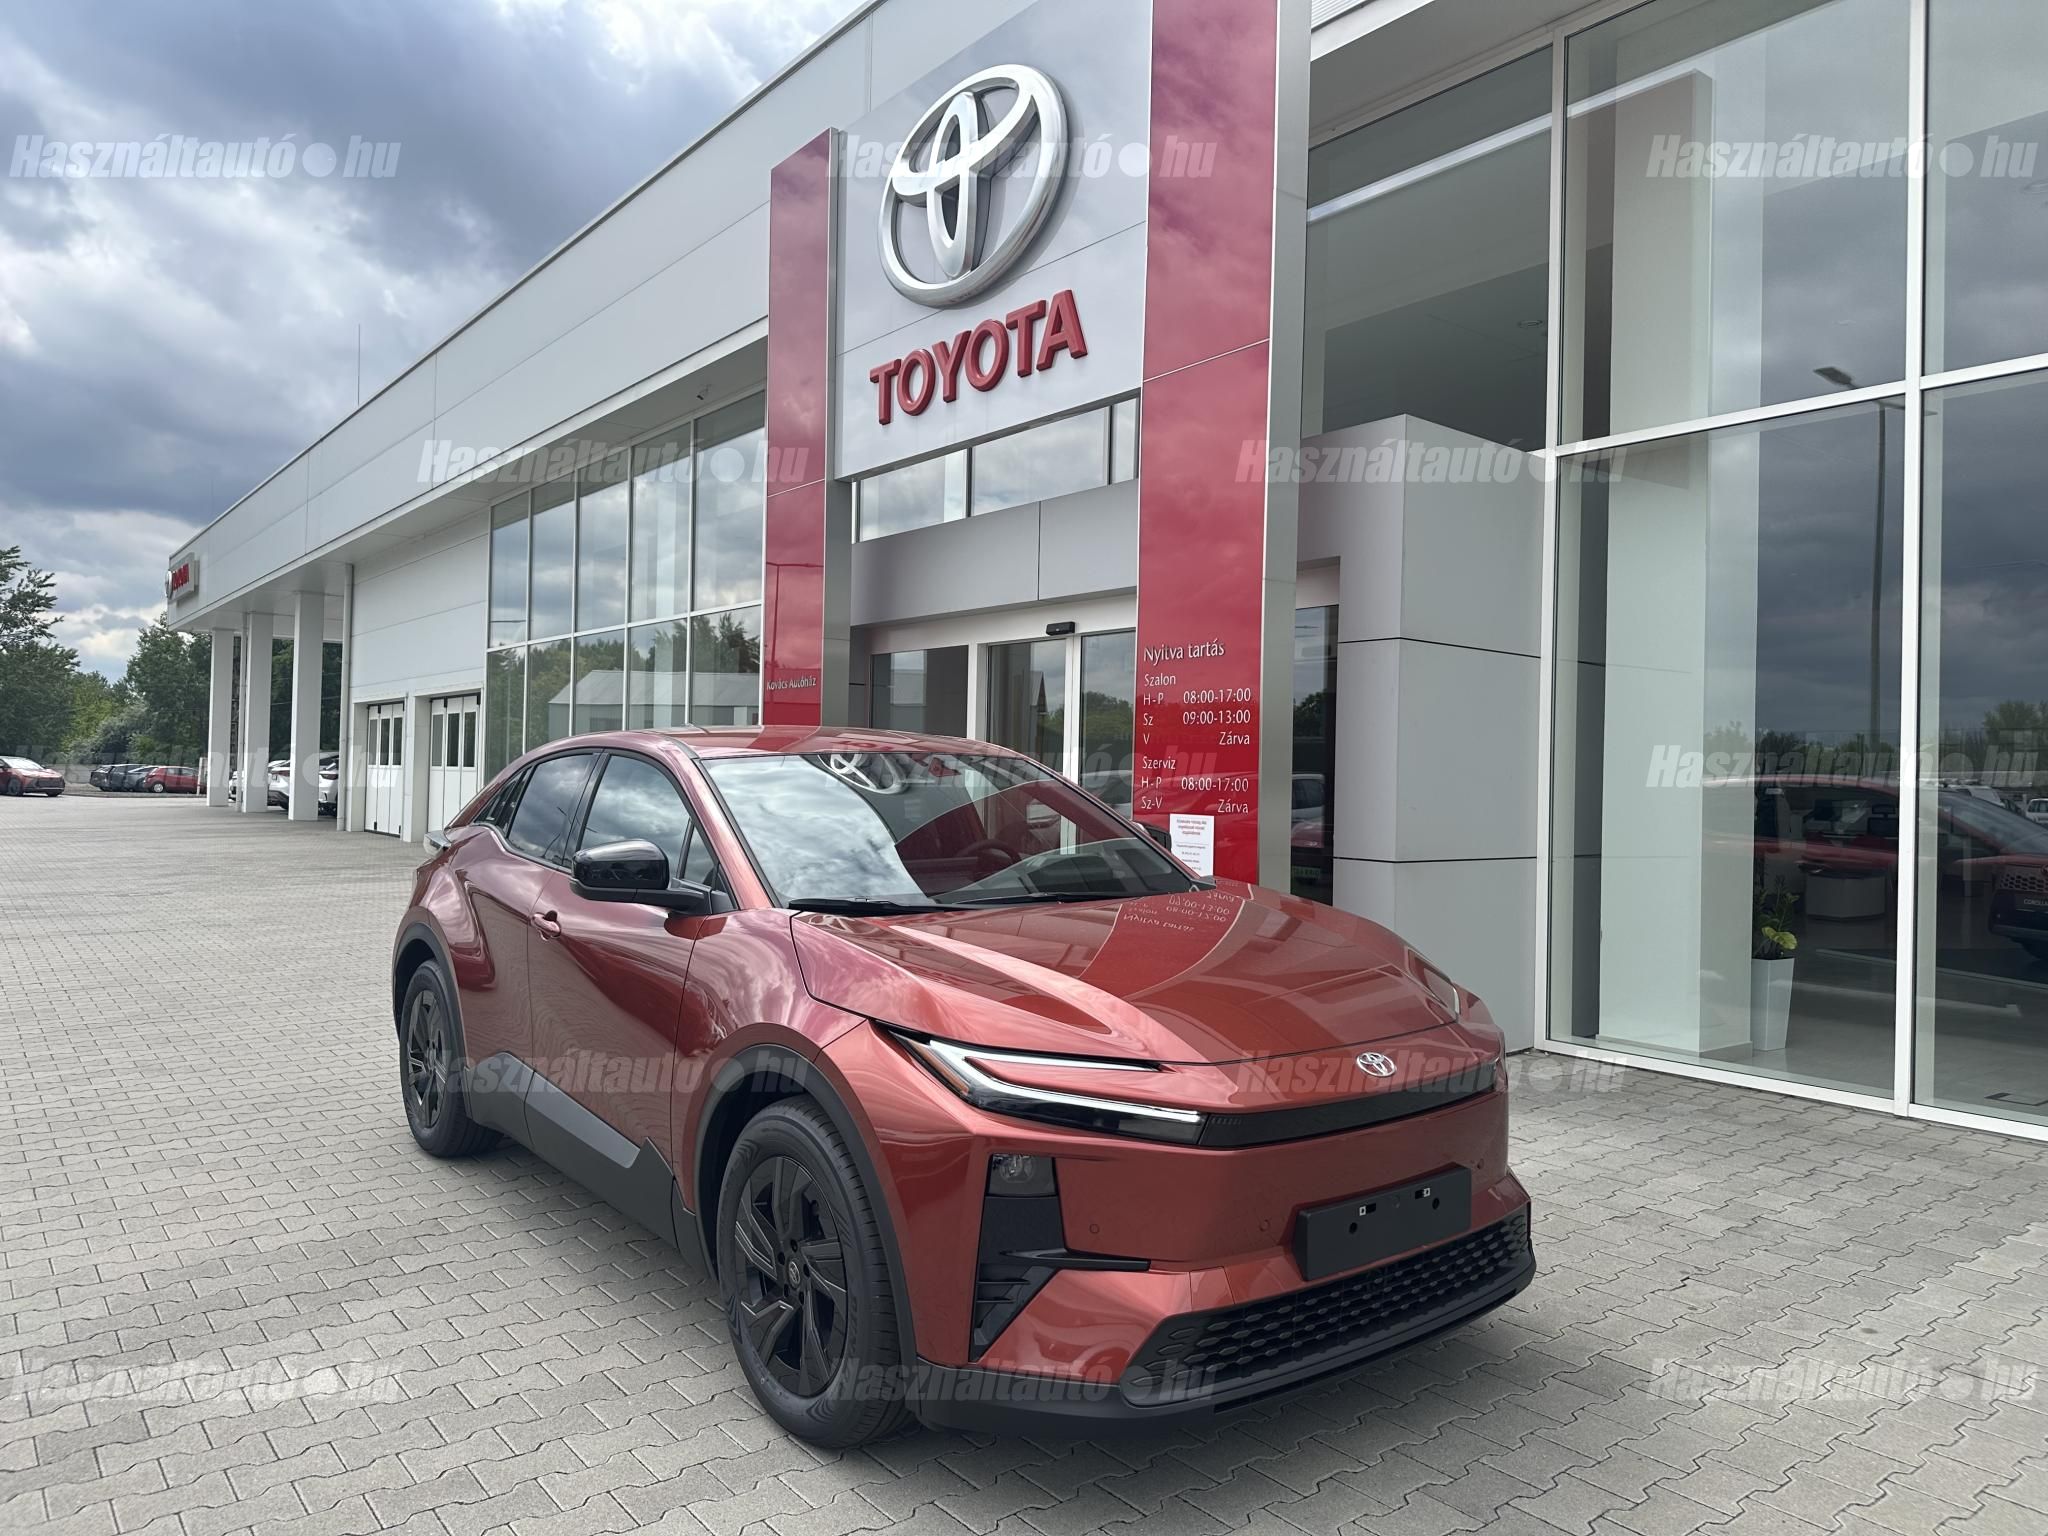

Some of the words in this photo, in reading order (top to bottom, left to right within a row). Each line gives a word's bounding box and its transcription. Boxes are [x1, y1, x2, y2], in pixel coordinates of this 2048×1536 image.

[870, 289, 1087, 425] TOYOTA
[1144, 644, 1184, 667] Nyitva
[1188, 638, 1225, 659] tartás
[1144, 674, 1176, 687] Szalon
[1183, 687, 1251, 704] 08:00-17:00
[1143, 713, 1154, 727] Sz
[1183, 709, 1251, 725] 09:00-13:00
[1143, 733, 1151, 745] V
[1219, 730, 1250, 746] Zárva
[1142, 755, 1176, 771] Szerviz
[1181, 777, 1249, 792] 08:00-17:00
[1141, 796, 1163, 810] Sz-V
[1217, 798, 1249, 814] Zárva
